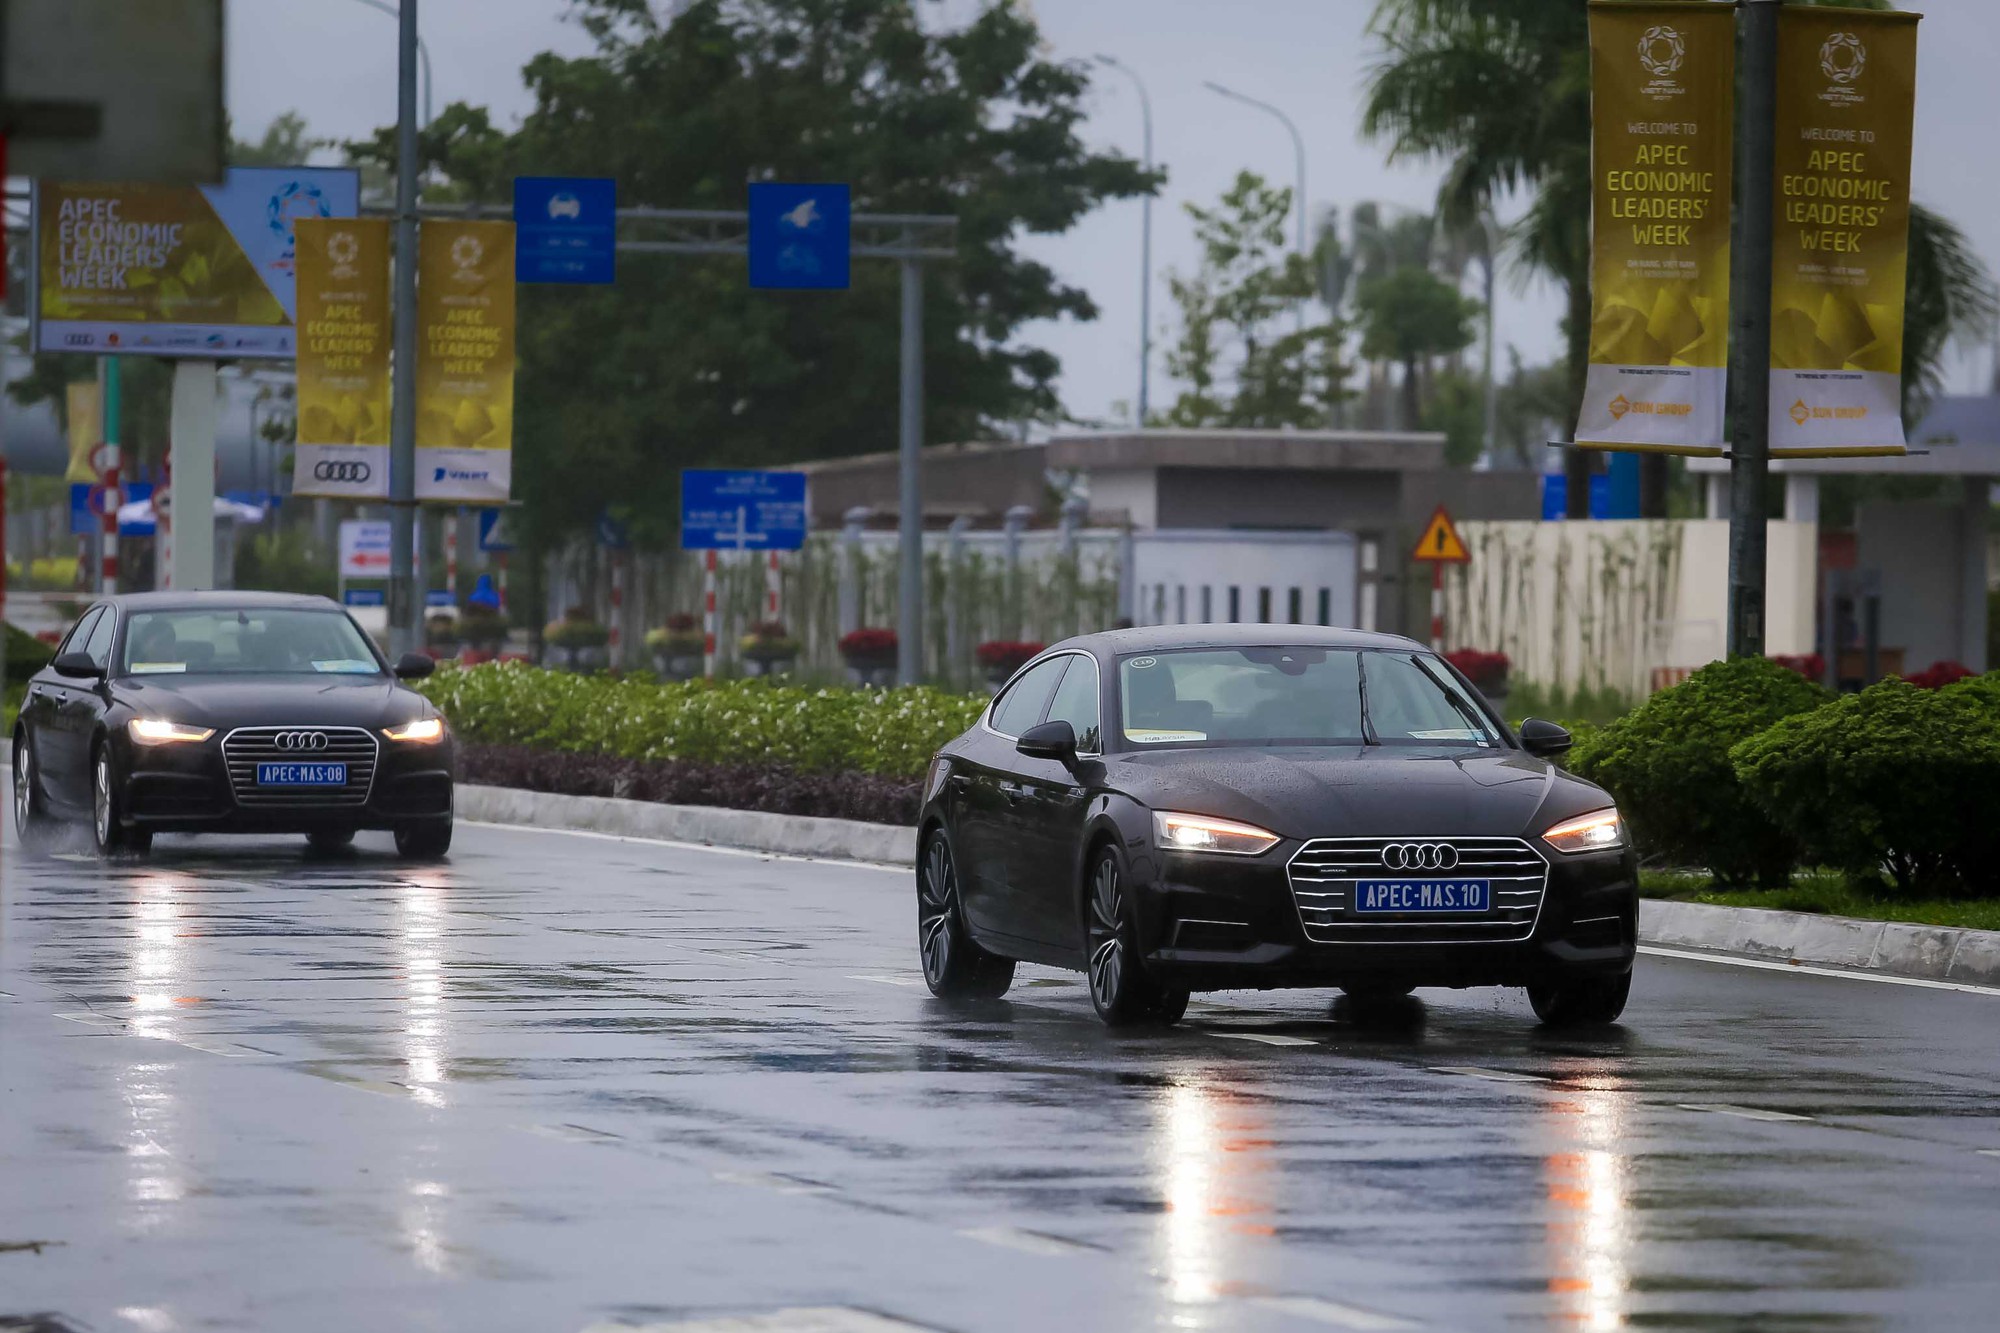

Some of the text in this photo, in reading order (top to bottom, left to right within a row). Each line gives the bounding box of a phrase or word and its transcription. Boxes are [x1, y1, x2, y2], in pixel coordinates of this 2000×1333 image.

[1627, 122, 1697, 135] WELCOME TO
[1801, 127, 1875, 143] WELCOME TO
[1636, 144, 1688, 166] APEC
[1807, 150, 1865, 173] APEC
[1607, 170, 1713, 193] ECONOMIC
[1783, 175, 1891, 201] ECONOMIC
[59, 198, 121, 222] APEC
[1612, 199, 1709, 219] LEADERS'
[1786, 203, 1885, 227] LEADERS'
[59, 221, 183, 247] ECONOMIC
[1632, 224, 1691, 246] WEEK
[1800, 230, 1863, 252] WEEK
[60, 243, 173, 268] LEADERS'
[59, 266, 127, 289] WEEK
[326, 305, 361, 319] APEC
[446, 309, 484, 324] APEC
[306, 320, 379, 337] ECONOMIC
[428, 325, 501, 341] ECONOMIC
[324, 355, 363, 370] WEEK
[443, 359, 484, 374] WEEK
